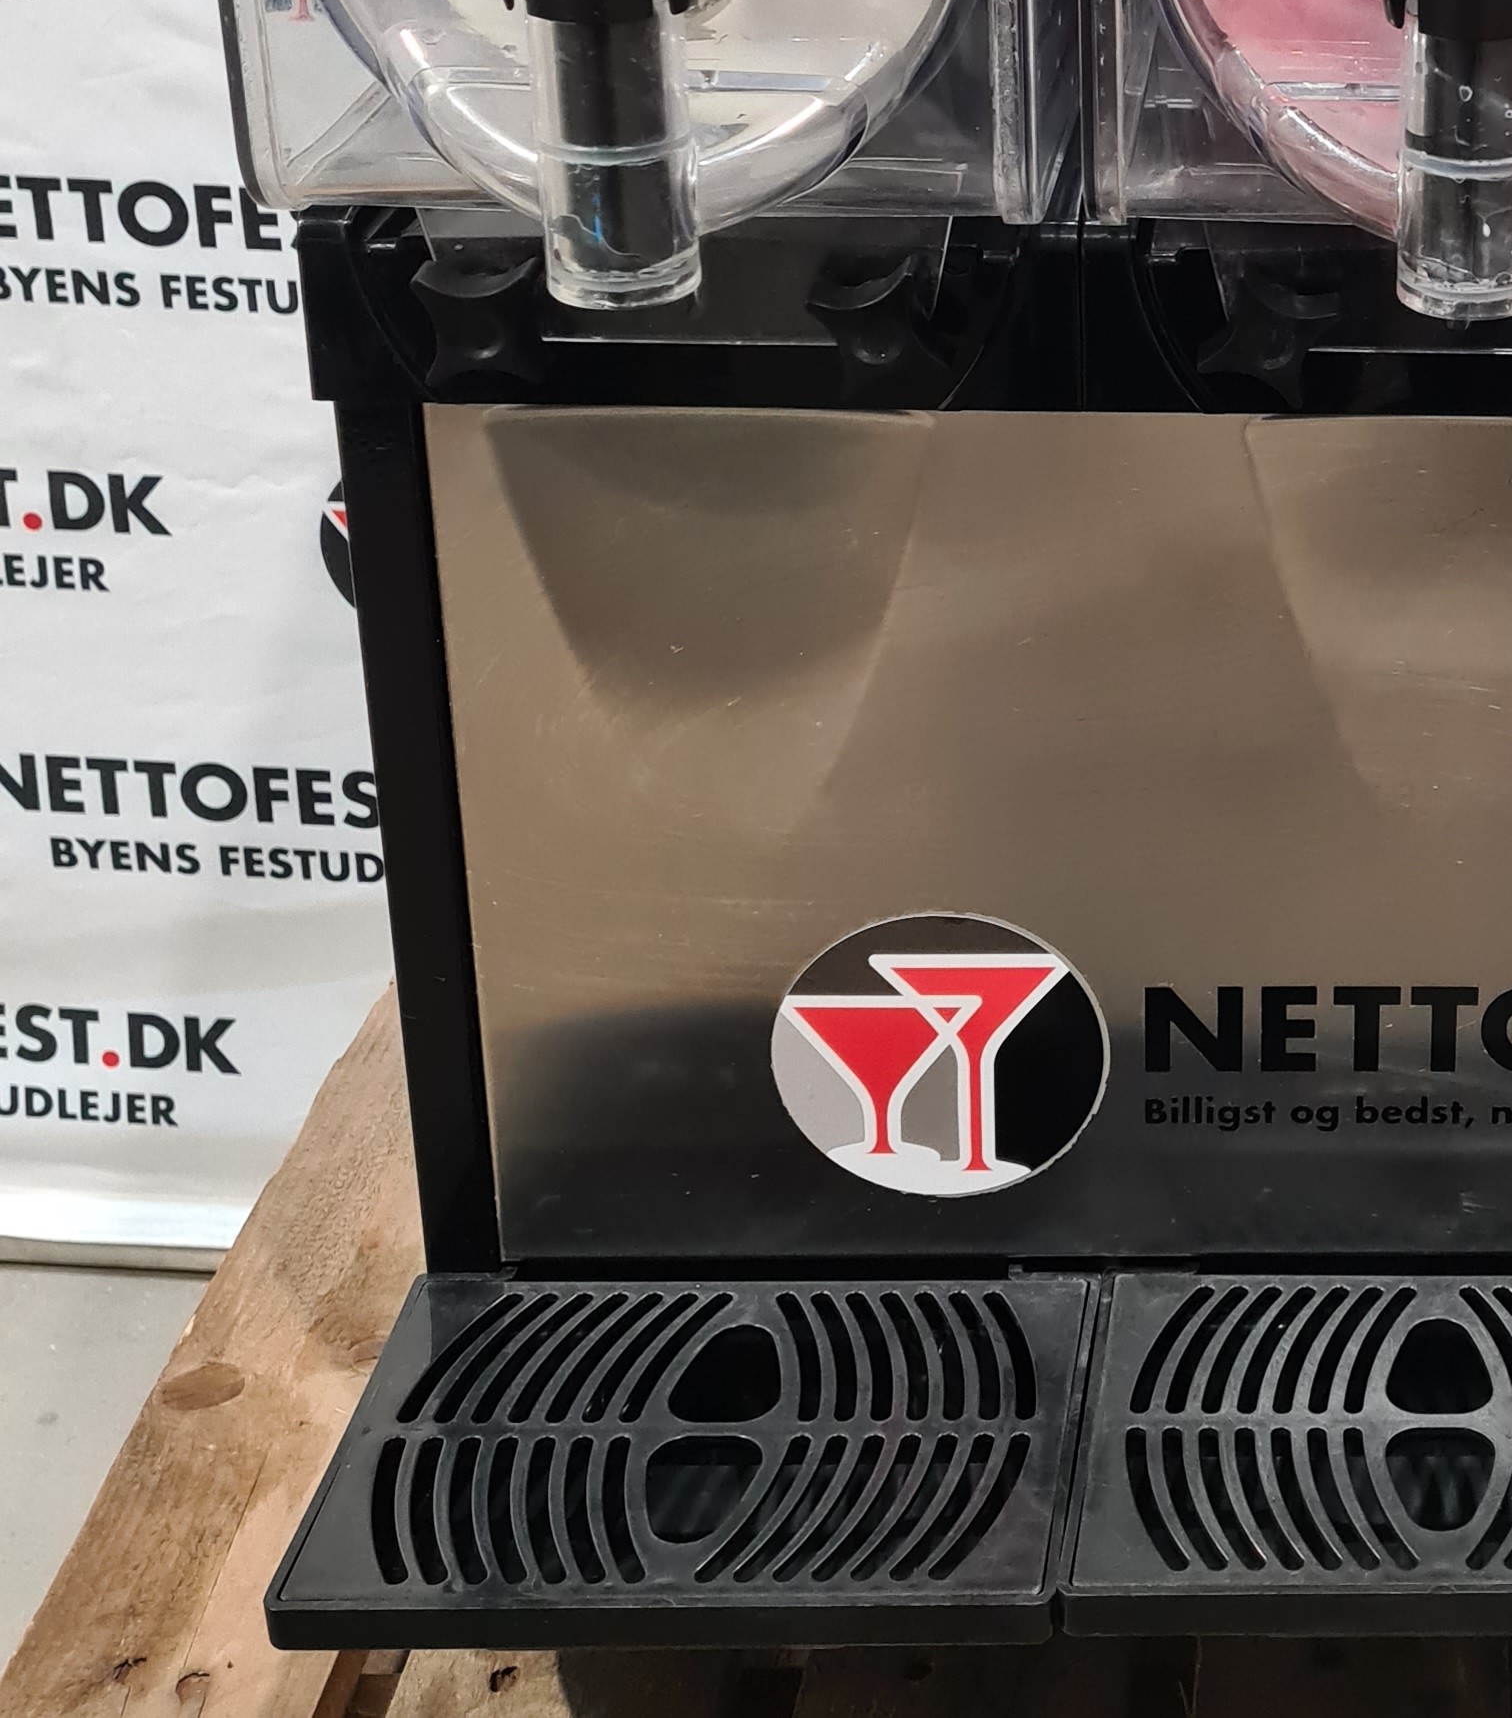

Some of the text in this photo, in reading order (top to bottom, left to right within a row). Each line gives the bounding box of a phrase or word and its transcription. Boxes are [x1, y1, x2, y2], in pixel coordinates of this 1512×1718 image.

[0, 175, 298, 252] TTOFE
[160, 274, 298, 315] FESTU
[0, 554, 110, 593] EJER
[50, 836, 385, 883] BYENS FESTUD
[0, 1003, 242, 1076] ST.DK
[1144, 1096, 1277, 1132] Billigst
[1290, 1104, 1340, 1132] og
[1354, 1095, 1476, 1129] bedst,
